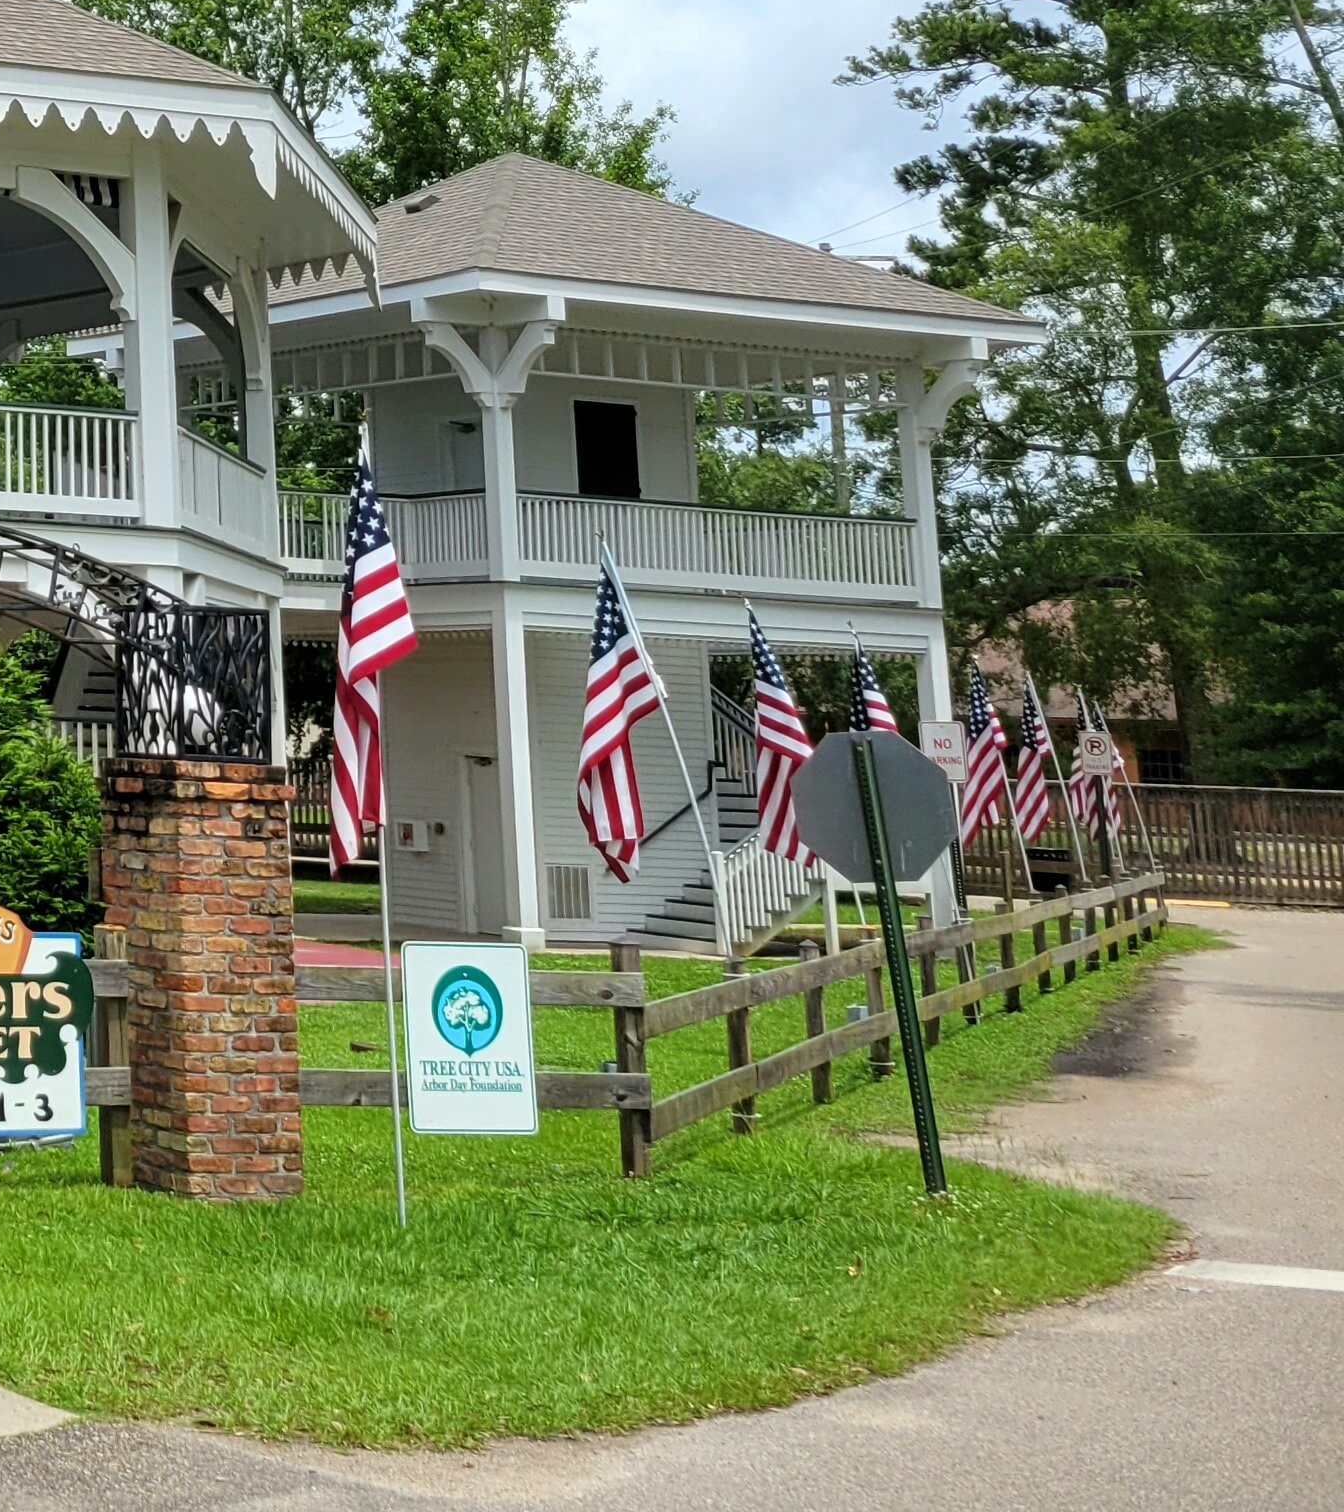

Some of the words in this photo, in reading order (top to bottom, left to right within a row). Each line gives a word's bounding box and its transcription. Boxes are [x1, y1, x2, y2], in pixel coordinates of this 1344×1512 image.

[933, 738, 952, 750] NO
[932, 755, 962, 765] ARKING
[419, 1060, 457, 1076] TREE
[458, 1060, 491, 1076] CITY
[494, 1061, 522, 1077] USA
[421, 1079, 449, 1091] Arbor
[450, 1079, 468, 1093] Day
[469, 1079, 522, 1092] Foundation
[33, 1093, 54, 1122] 3
